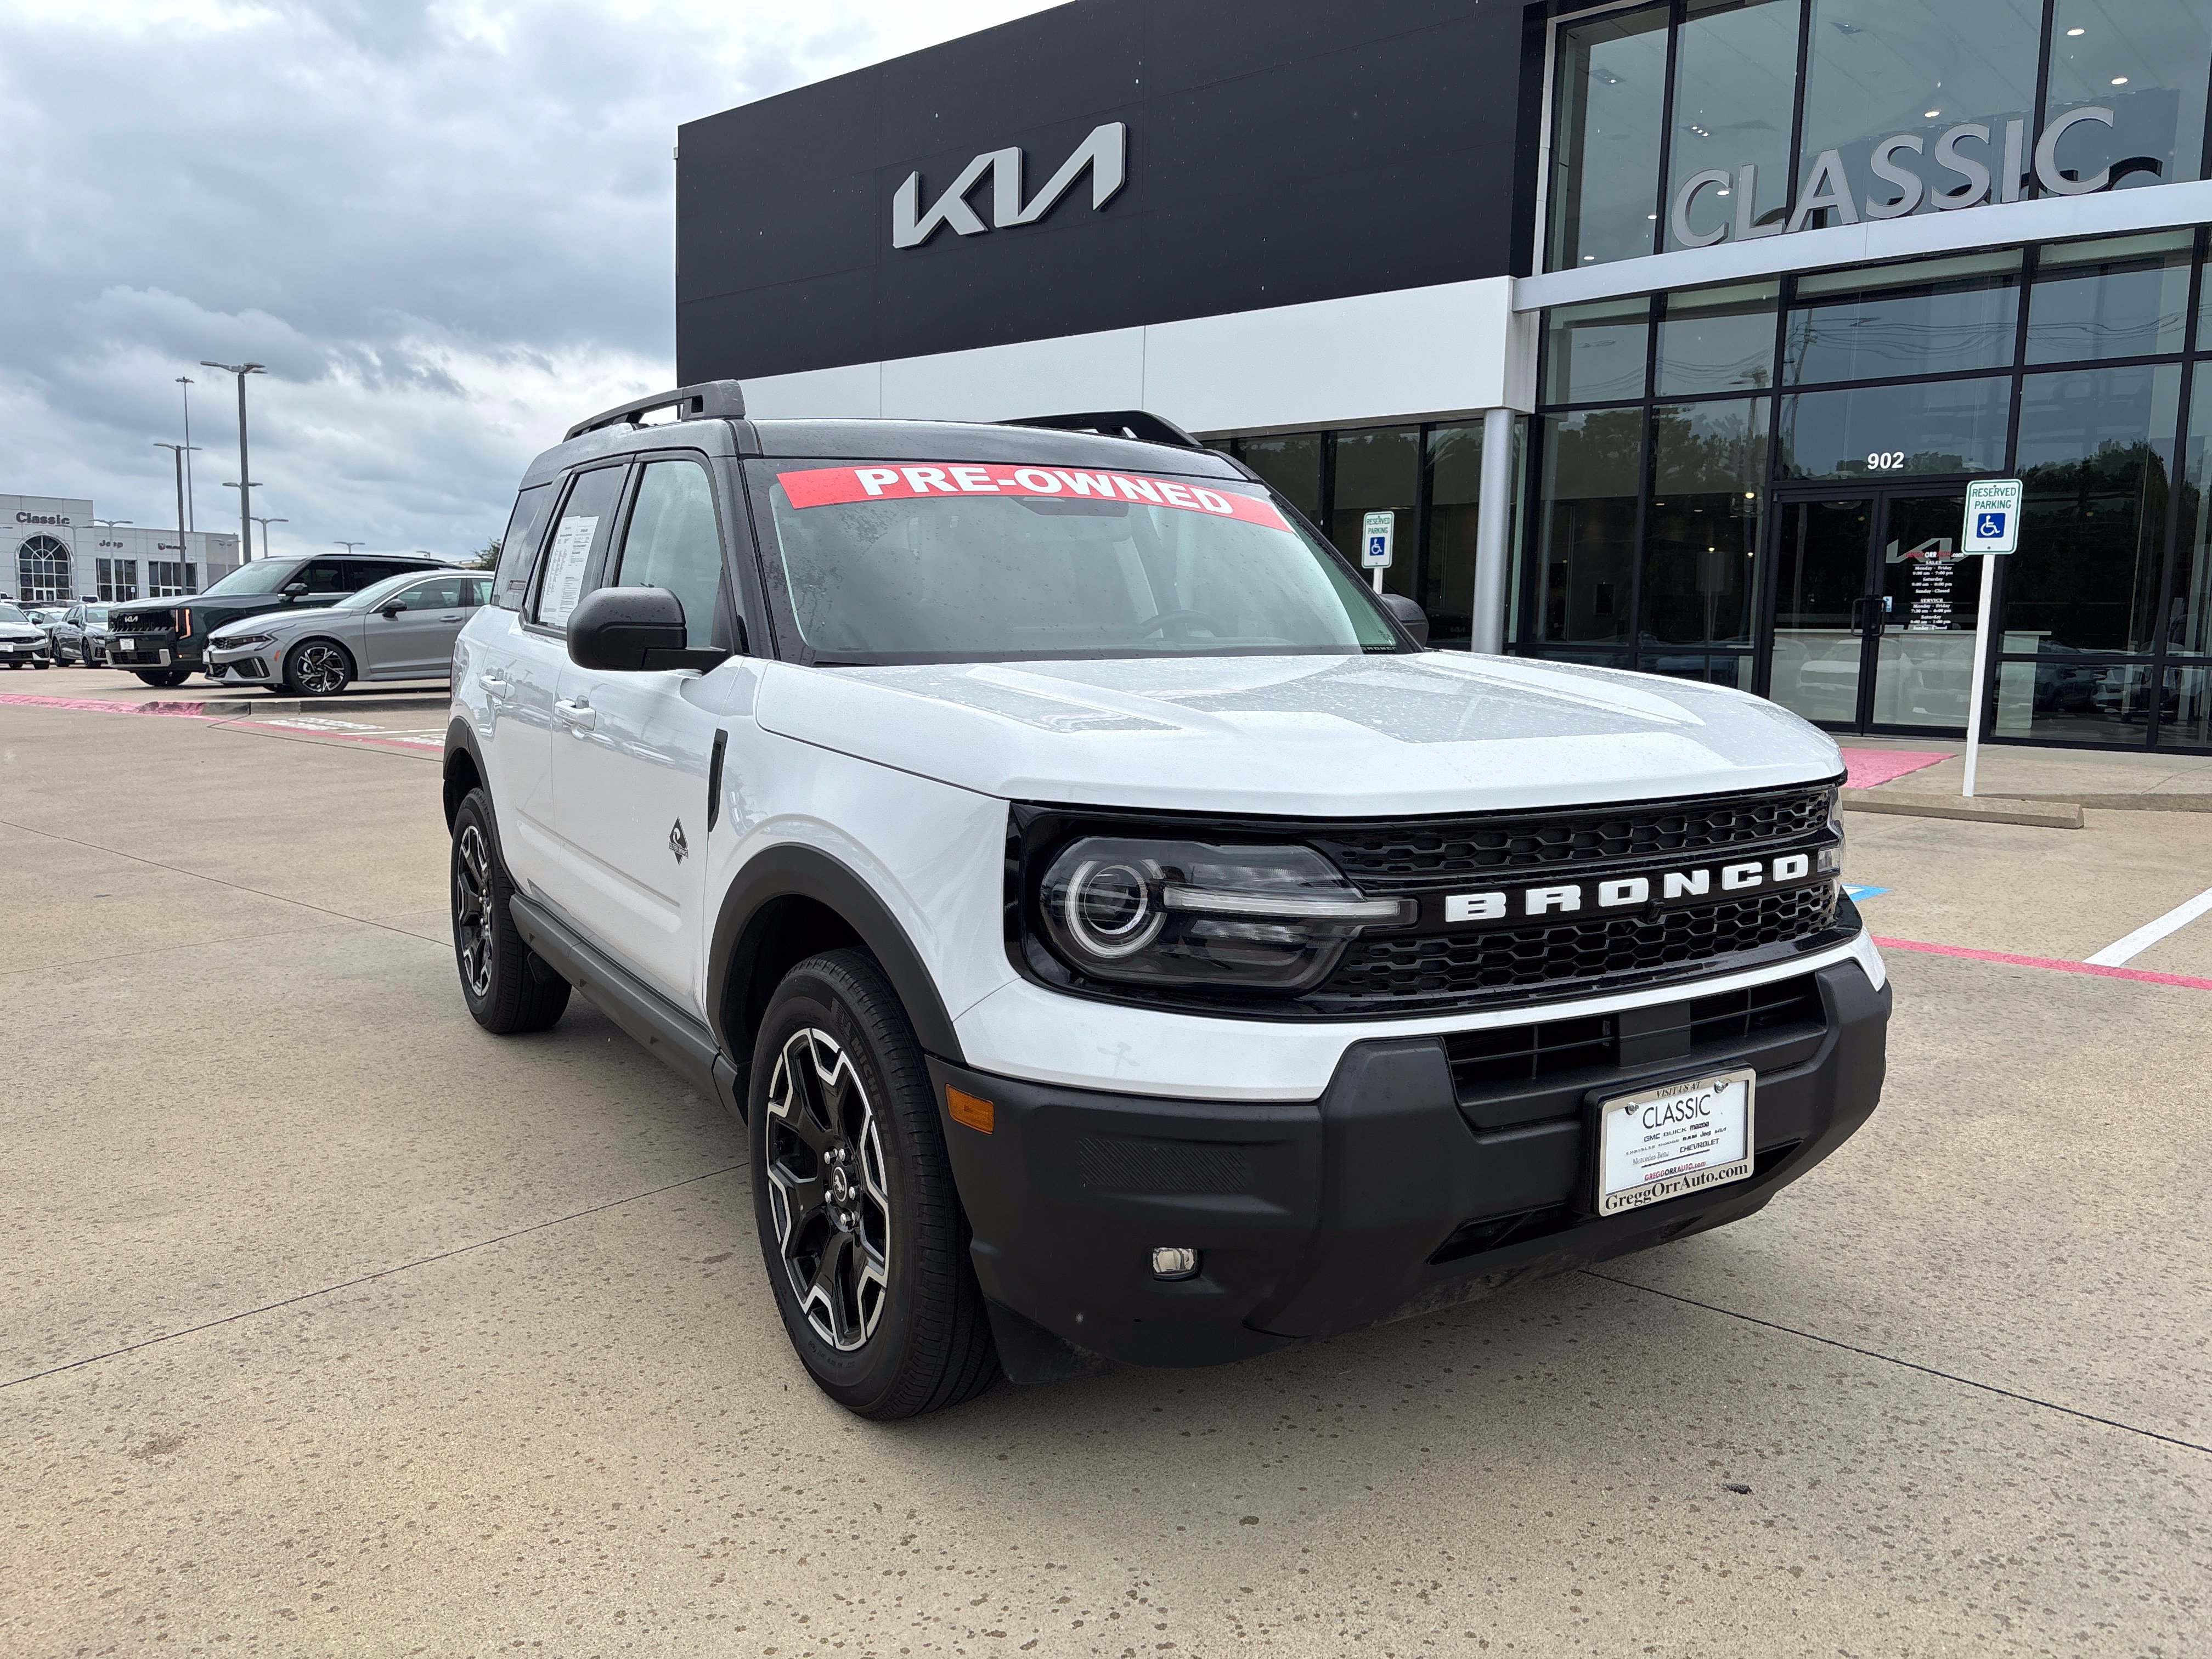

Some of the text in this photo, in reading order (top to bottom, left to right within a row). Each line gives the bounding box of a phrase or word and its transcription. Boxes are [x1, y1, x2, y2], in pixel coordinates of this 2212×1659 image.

[893, 121, 1126, 249] KIA
[1671, 106, 2115, 246] CLASSIC
[1867, 452, 1904, 470] 902
[854, 466, 1233, 515] PRE-OWNED
[1972, 487, 2016, 497] RESERVED
[1974, 499, 2011, 509] PARKING
[16, 511, 70, 525] Classic
[1445, 854, 1809, 923] BRONCO
[1657, 1081, 1702, 1098] VISIT US AT
[1643, 1094, 1711, 1129] CLASSIC
[1644, 1133, 1660, 1142] GMC
[1663, 1127, 1687, 1137] BUICK
[1680, 1138, 1719, 1153] CHEVROLET
[1644, 1161, 1706, 1181] GREGGORRAUTO.com
[1605, 1164, 1748, 1210] GreggOrrAuto.com
